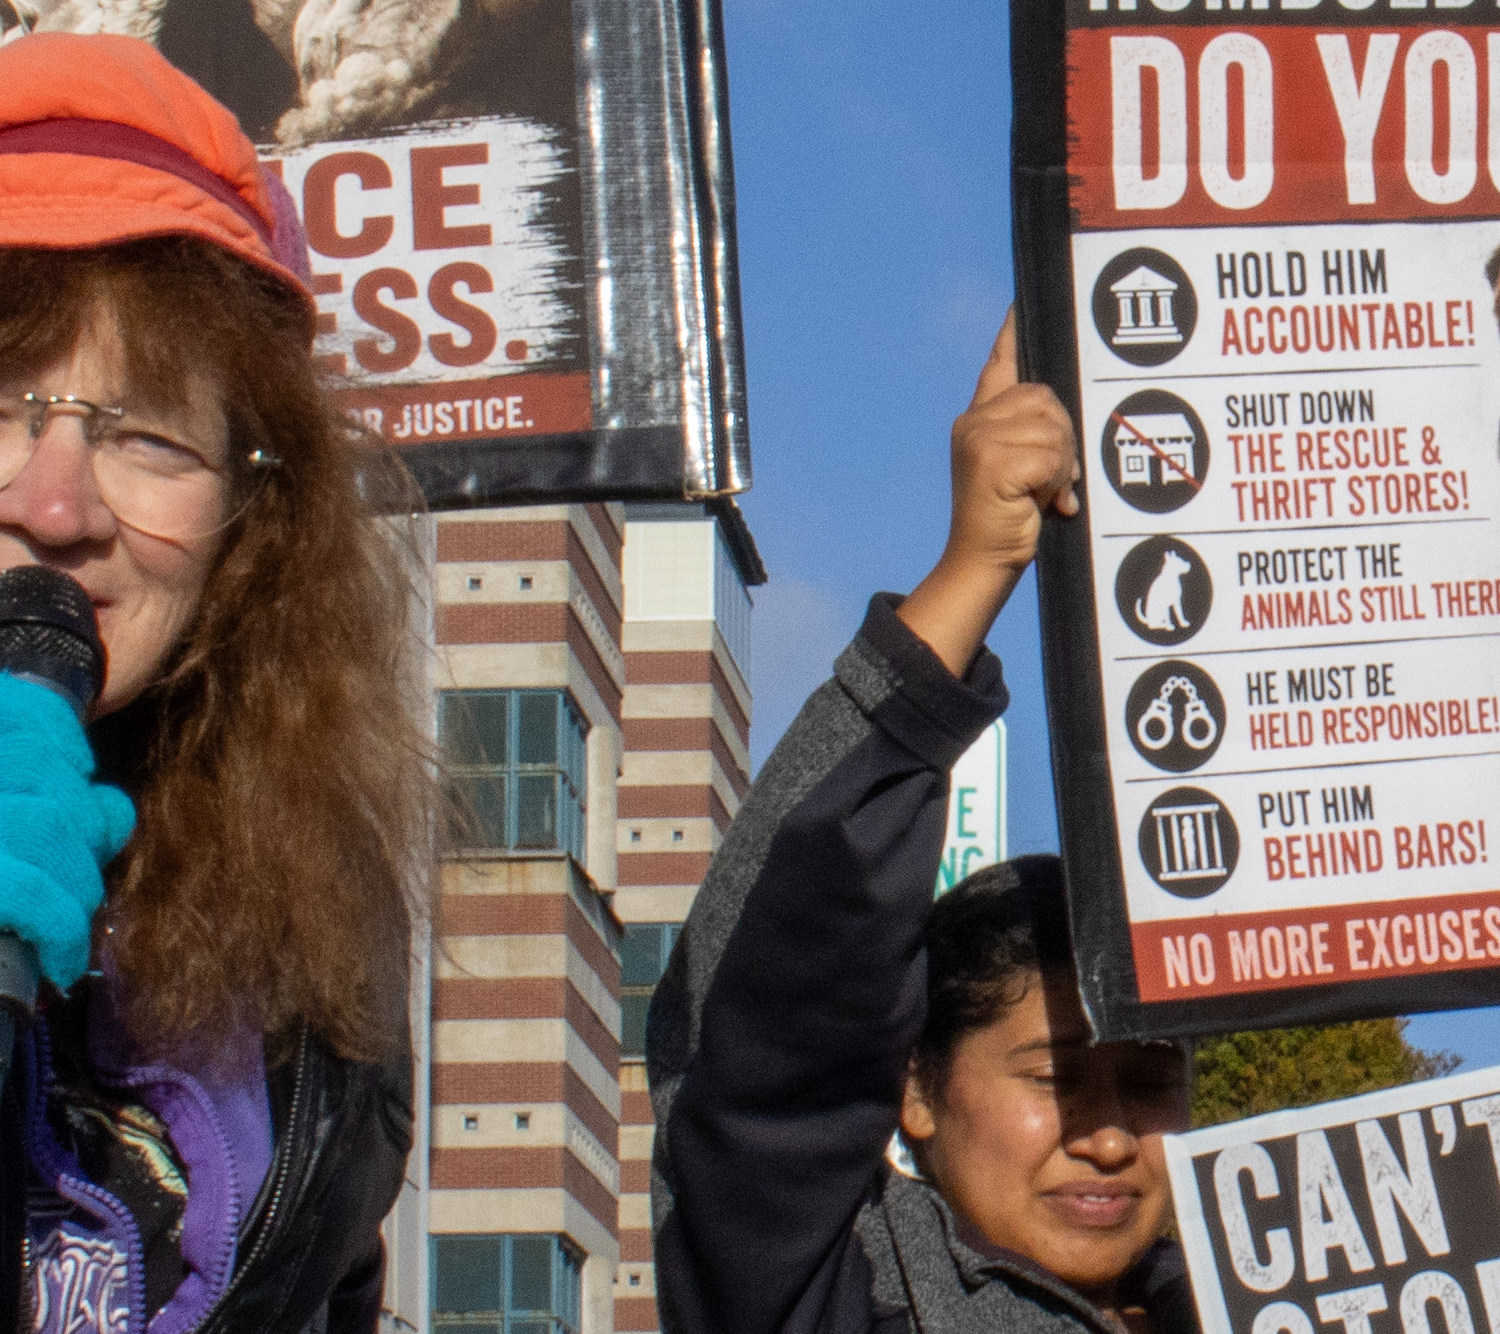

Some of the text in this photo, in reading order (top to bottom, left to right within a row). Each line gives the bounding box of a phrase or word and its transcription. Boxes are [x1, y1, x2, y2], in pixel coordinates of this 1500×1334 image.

[1109, 32, 1275, 211] DO
[1216, 248, 1388, 299] HOLD HIM
[1221, 300, 1475, 357] ACCOUNTABLE!
[393, 396, 533, 438] JUSTICE.
[1225, 389, 1375, 428] SHUT DOWN
[1228, 425, 1441, 475] THE RESCUE &
[1232, 471, 1470, 523] THRIFT STORES!
[1238, 543, 1403, 587] PROTECT THE
[1241, 587, 1353, 631] ANIMALS
[1360, 583, 1426, 623] STILL
[1247, 663, 1396, 706] HE MUST BE
[1249, 696, 1500, 751] HELD RESPONSIBLE!
[1258, 785, 1375, 829] PUT HIM
[1264, 819, 1488, 882] BEHIND BARS!
[1162, 933, 1216, 989] NO
[1229, 922, 1334, 983] MORE
